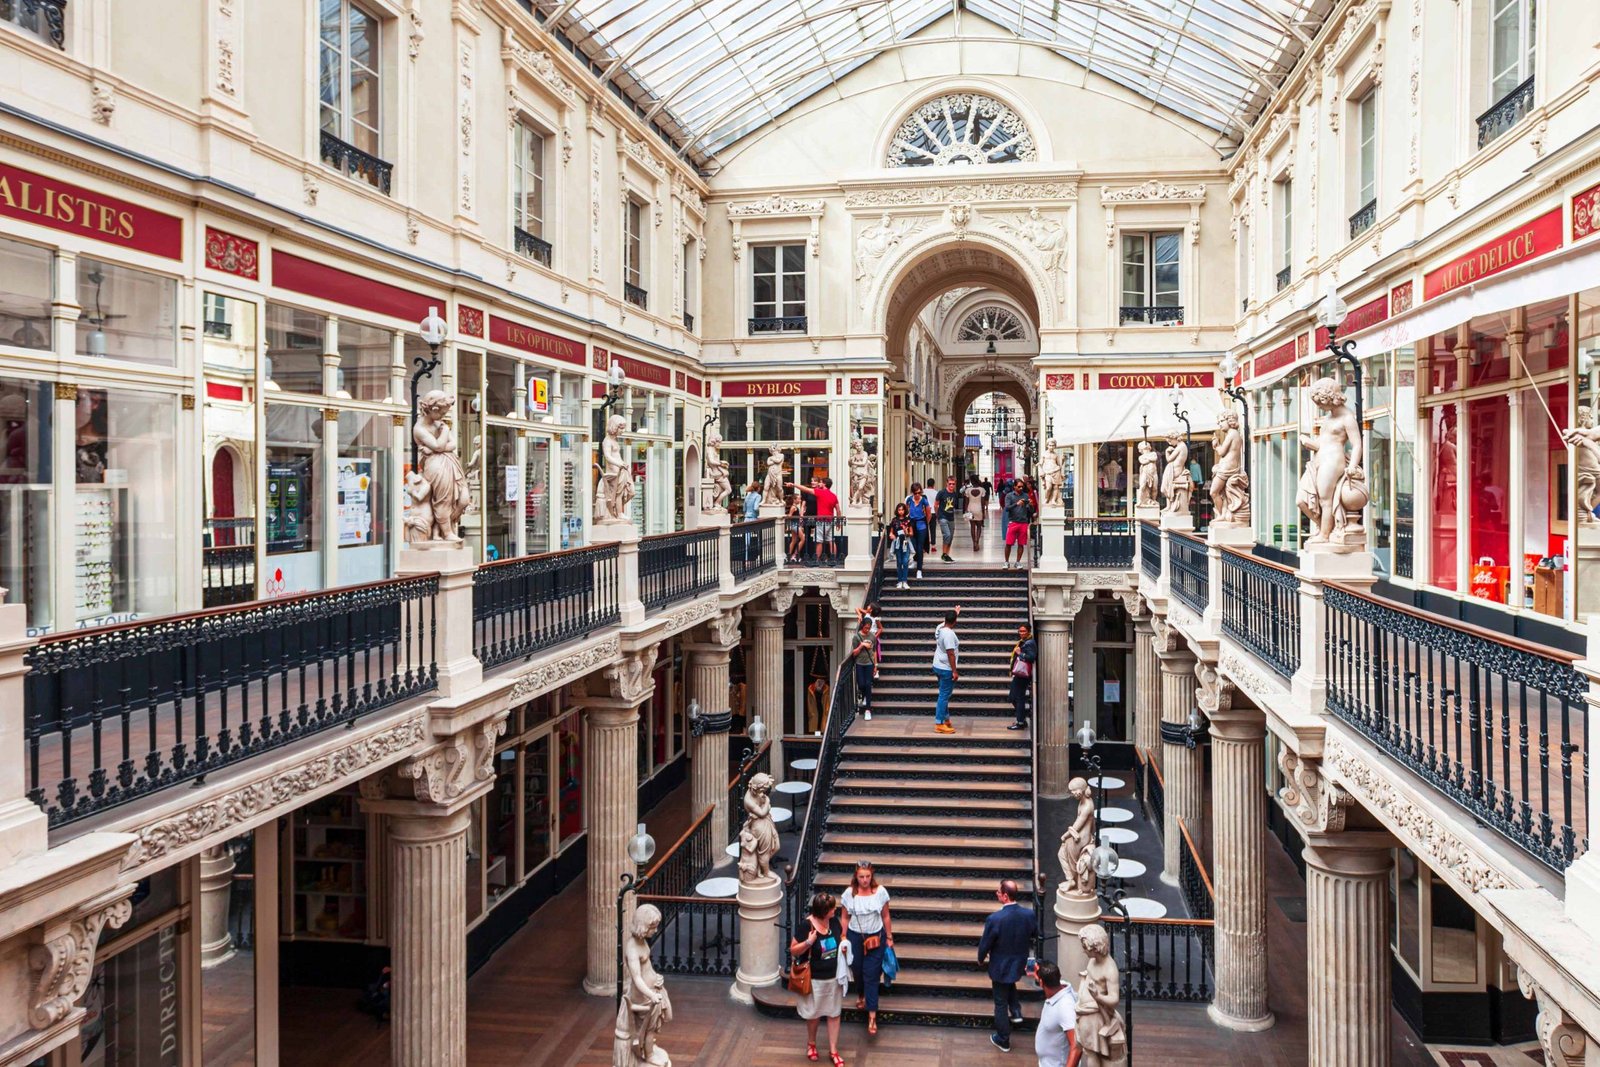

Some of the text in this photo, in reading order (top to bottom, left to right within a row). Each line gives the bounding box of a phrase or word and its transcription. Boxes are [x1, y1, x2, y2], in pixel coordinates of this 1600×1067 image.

[0, 175, 135, 239] ALISTES
[1440, 230, 1536, 293] ALICE DELICE
[507, 326, 574, 358] LES OPTICIENS
[747, 382, 802, 395] BYBLOS
[1110, 374, 1205, 388] COTON DOUX
